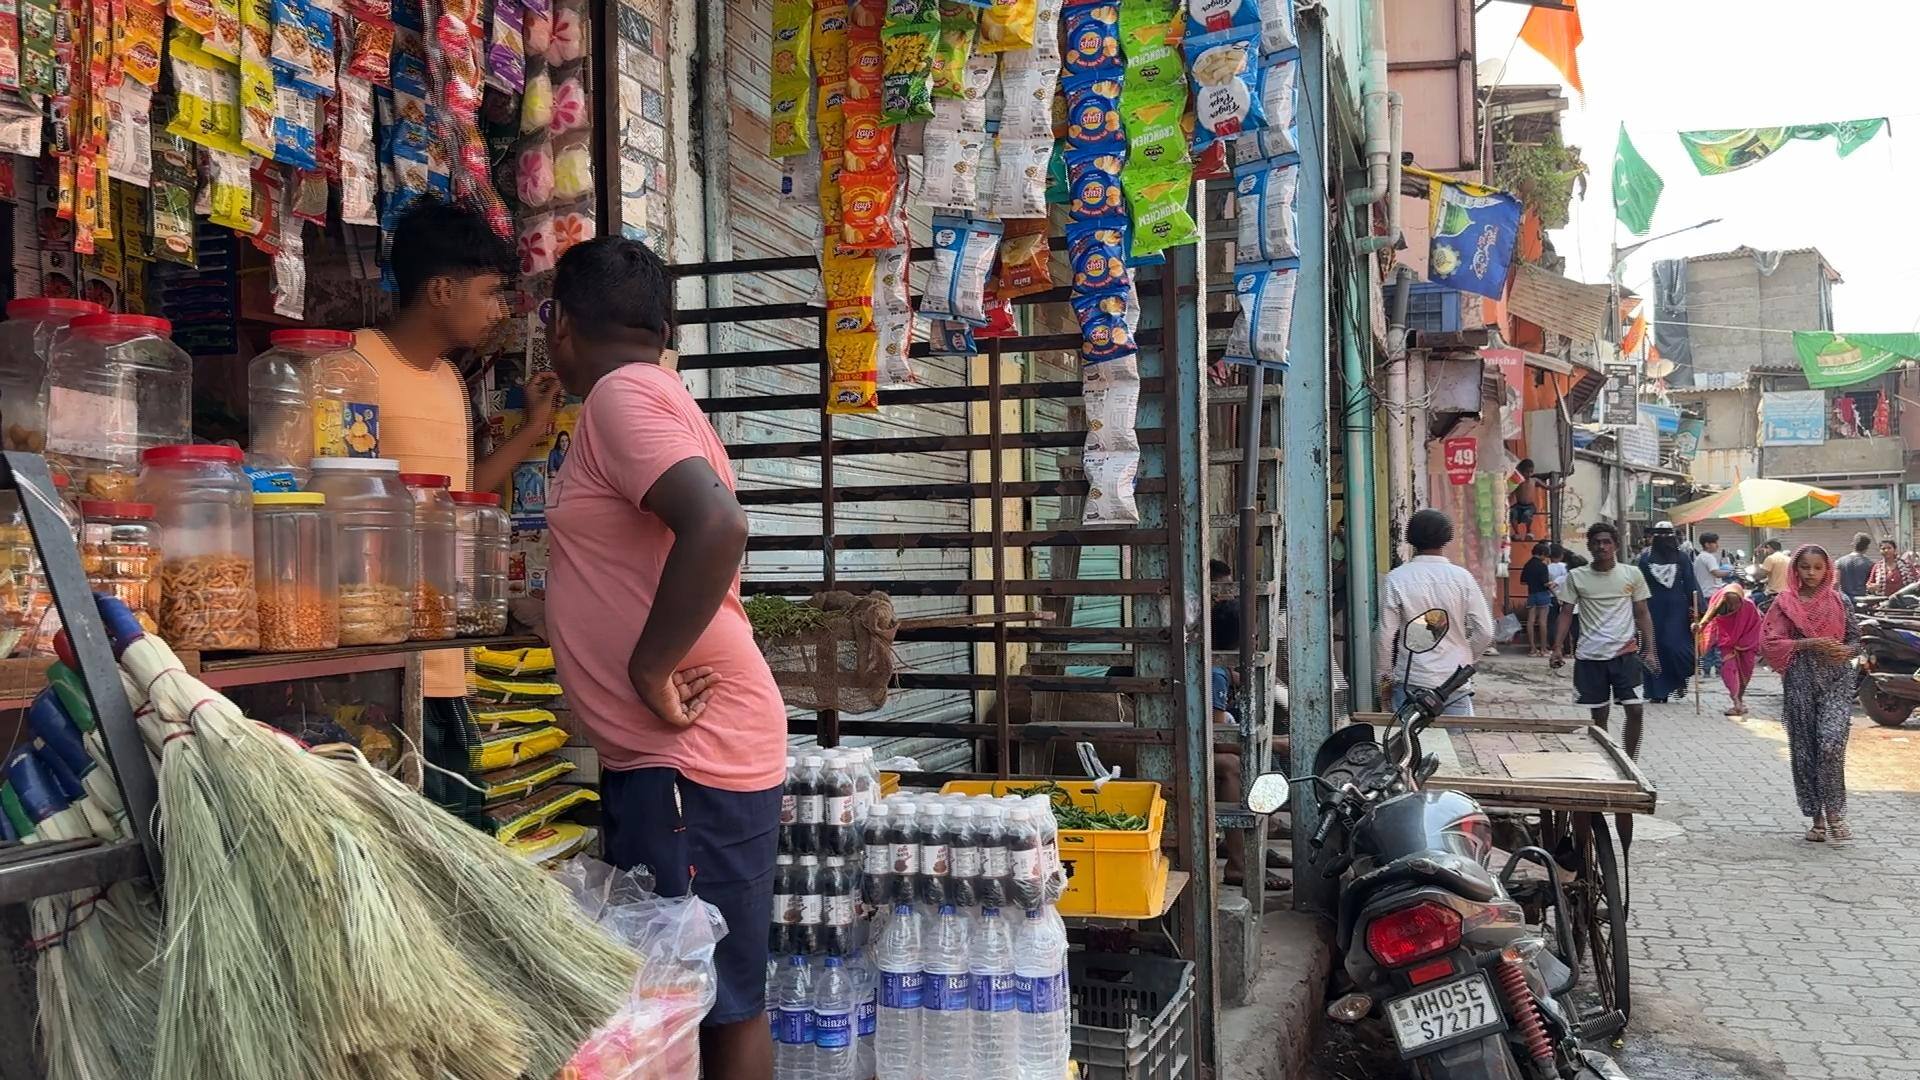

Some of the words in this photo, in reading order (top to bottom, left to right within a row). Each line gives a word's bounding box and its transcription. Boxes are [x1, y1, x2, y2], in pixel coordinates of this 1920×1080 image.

[1411, 981, 1482, 1019] MH05E
[816, 1017, 847, 1028] Rainzo
[1420, 1002, 1486, 1040] S7277
